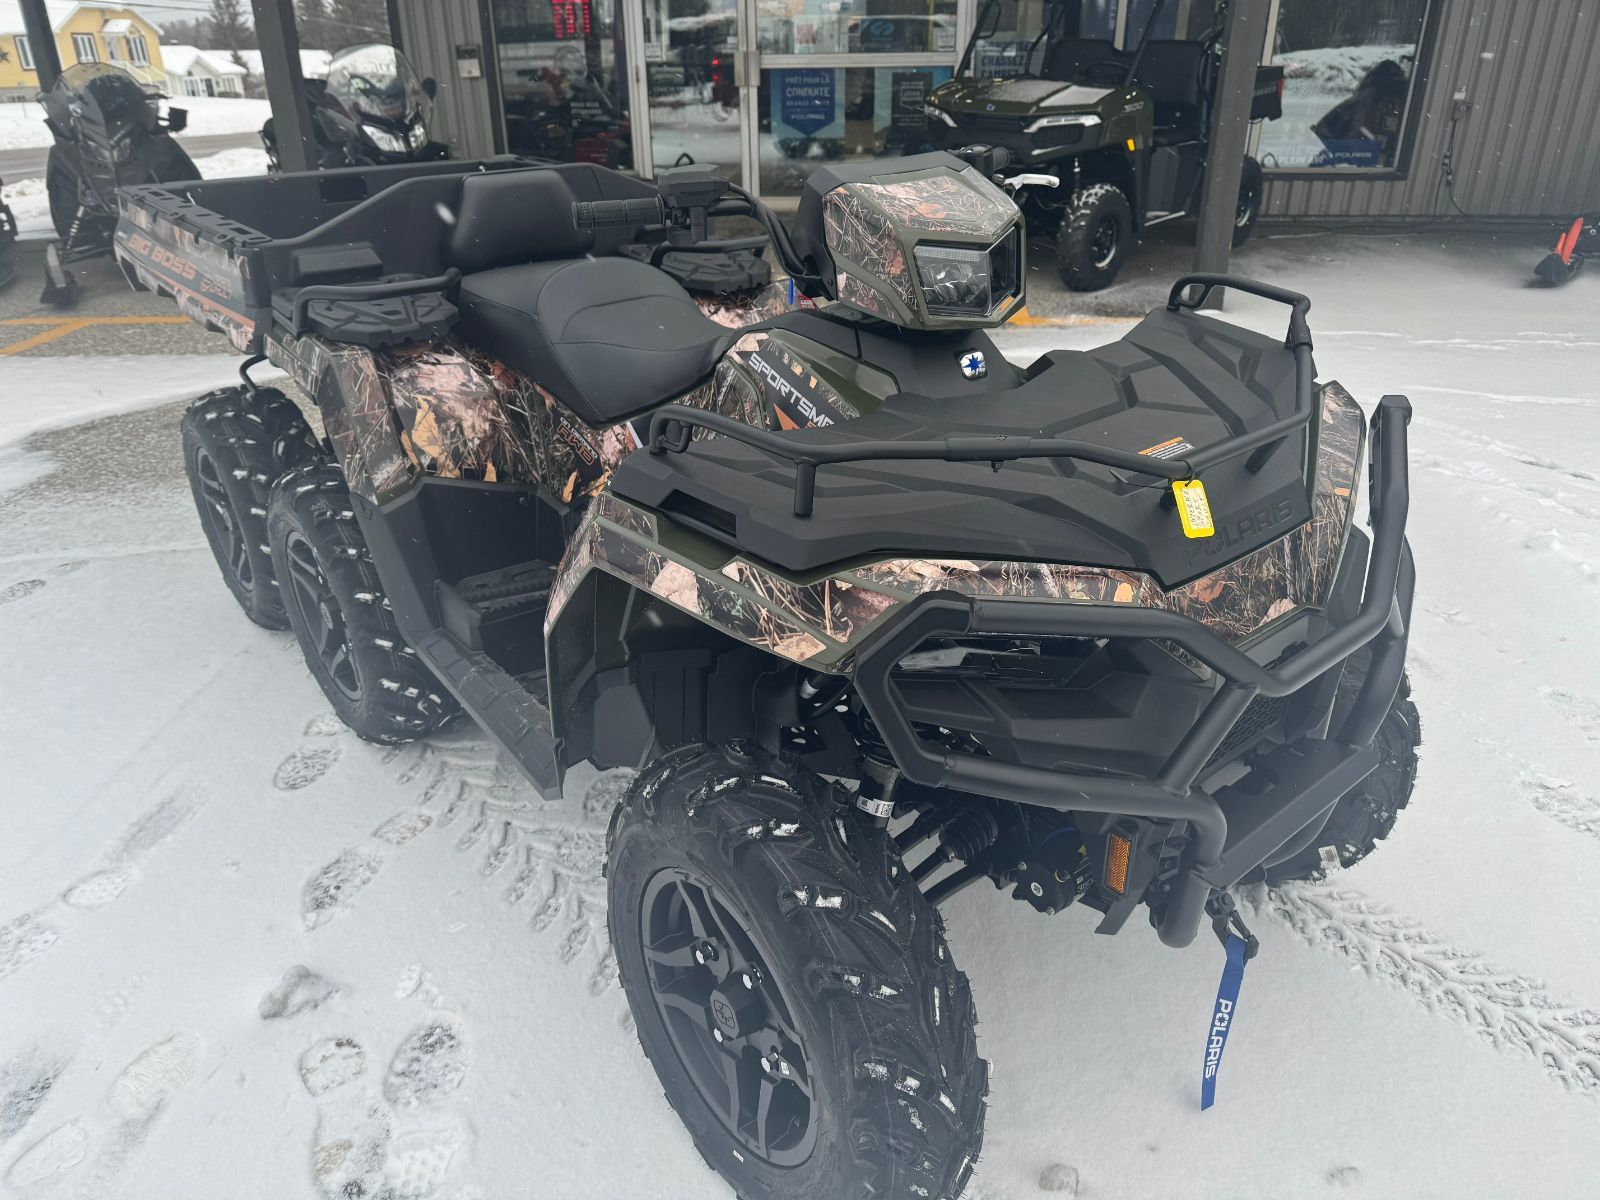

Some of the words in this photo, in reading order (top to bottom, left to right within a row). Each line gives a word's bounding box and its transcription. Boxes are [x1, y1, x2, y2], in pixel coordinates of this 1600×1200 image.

[982, 55, 1024, 66] CHASSEZ
[786, 87, 830, 97] CONDUITE
[1334, 151, 1372, 159] POLARIS
[128, 234, 153, 256] BIG
[151, 245, 198, 281] BOSS
[556, 423, 595, 465] AWD
[1184, 500, 1294, 568] POLARIS
[1204, 998, 1233, 1079] POLARIS
